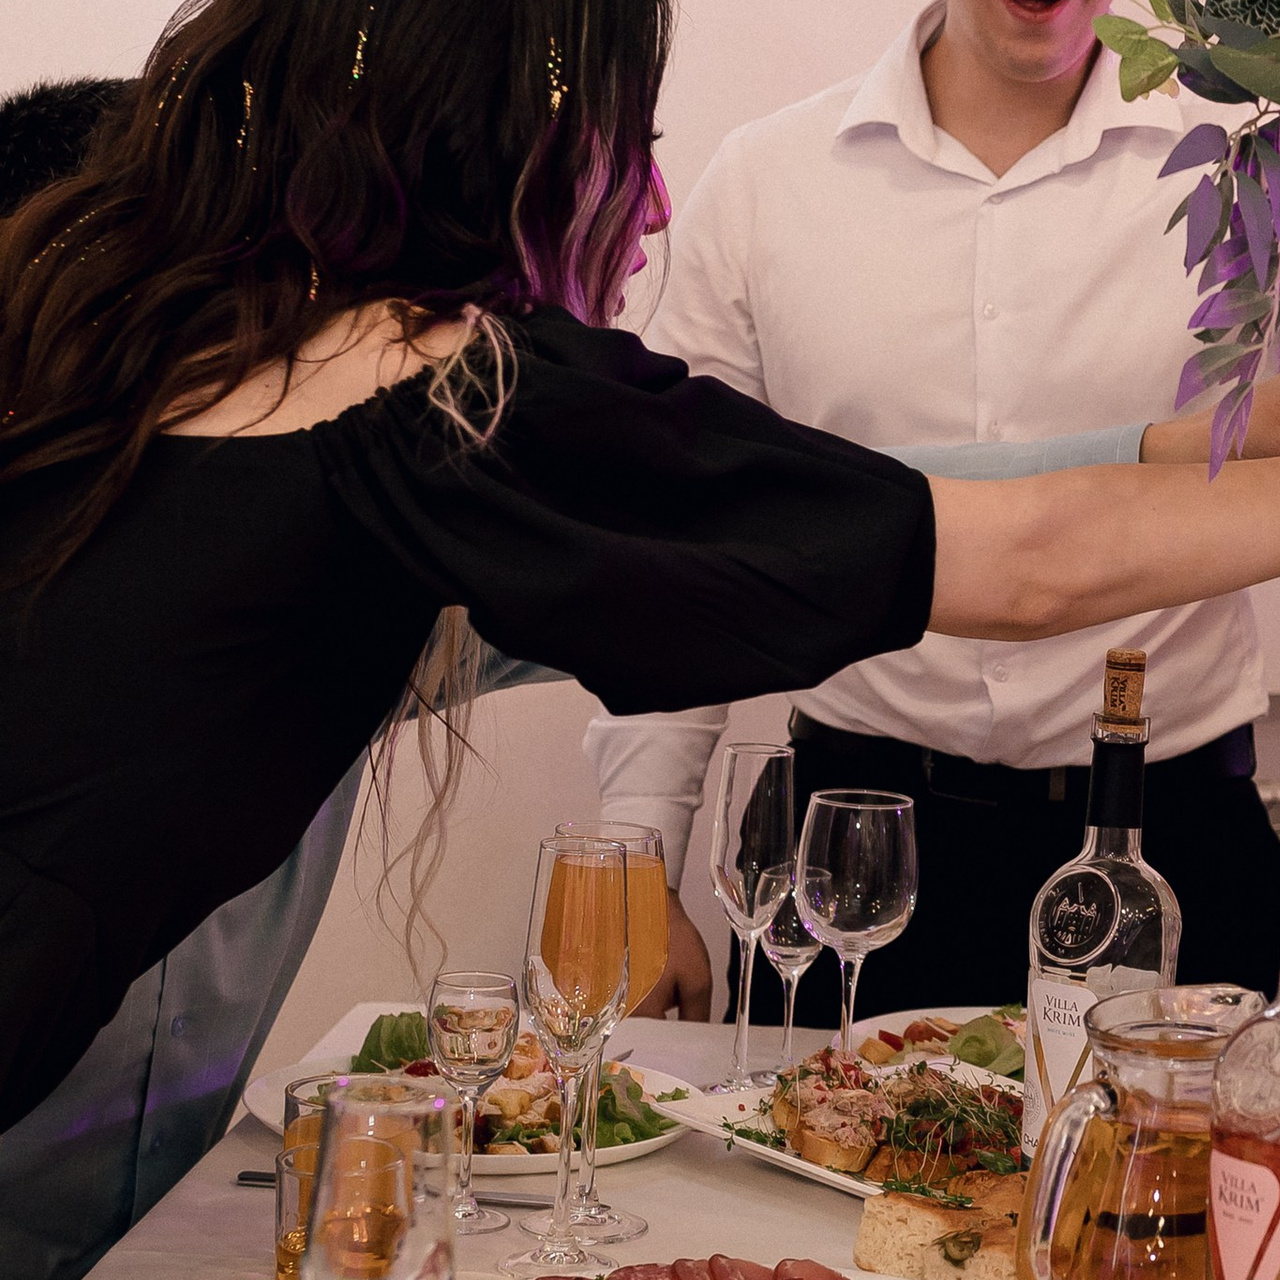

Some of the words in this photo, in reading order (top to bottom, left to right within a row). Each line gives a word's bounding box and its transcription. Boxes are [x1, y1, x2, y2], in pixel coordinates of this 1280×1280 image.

[1110, 676, 1120, 708] KRIM
[1045, 994, 1078, 1012] VILLA
[1043, 1006, 1081, 1027] KRIM
[1221, 1170, 1257, 1195] VILLA
[1219, 1183, 1260, 1213] KRIM
